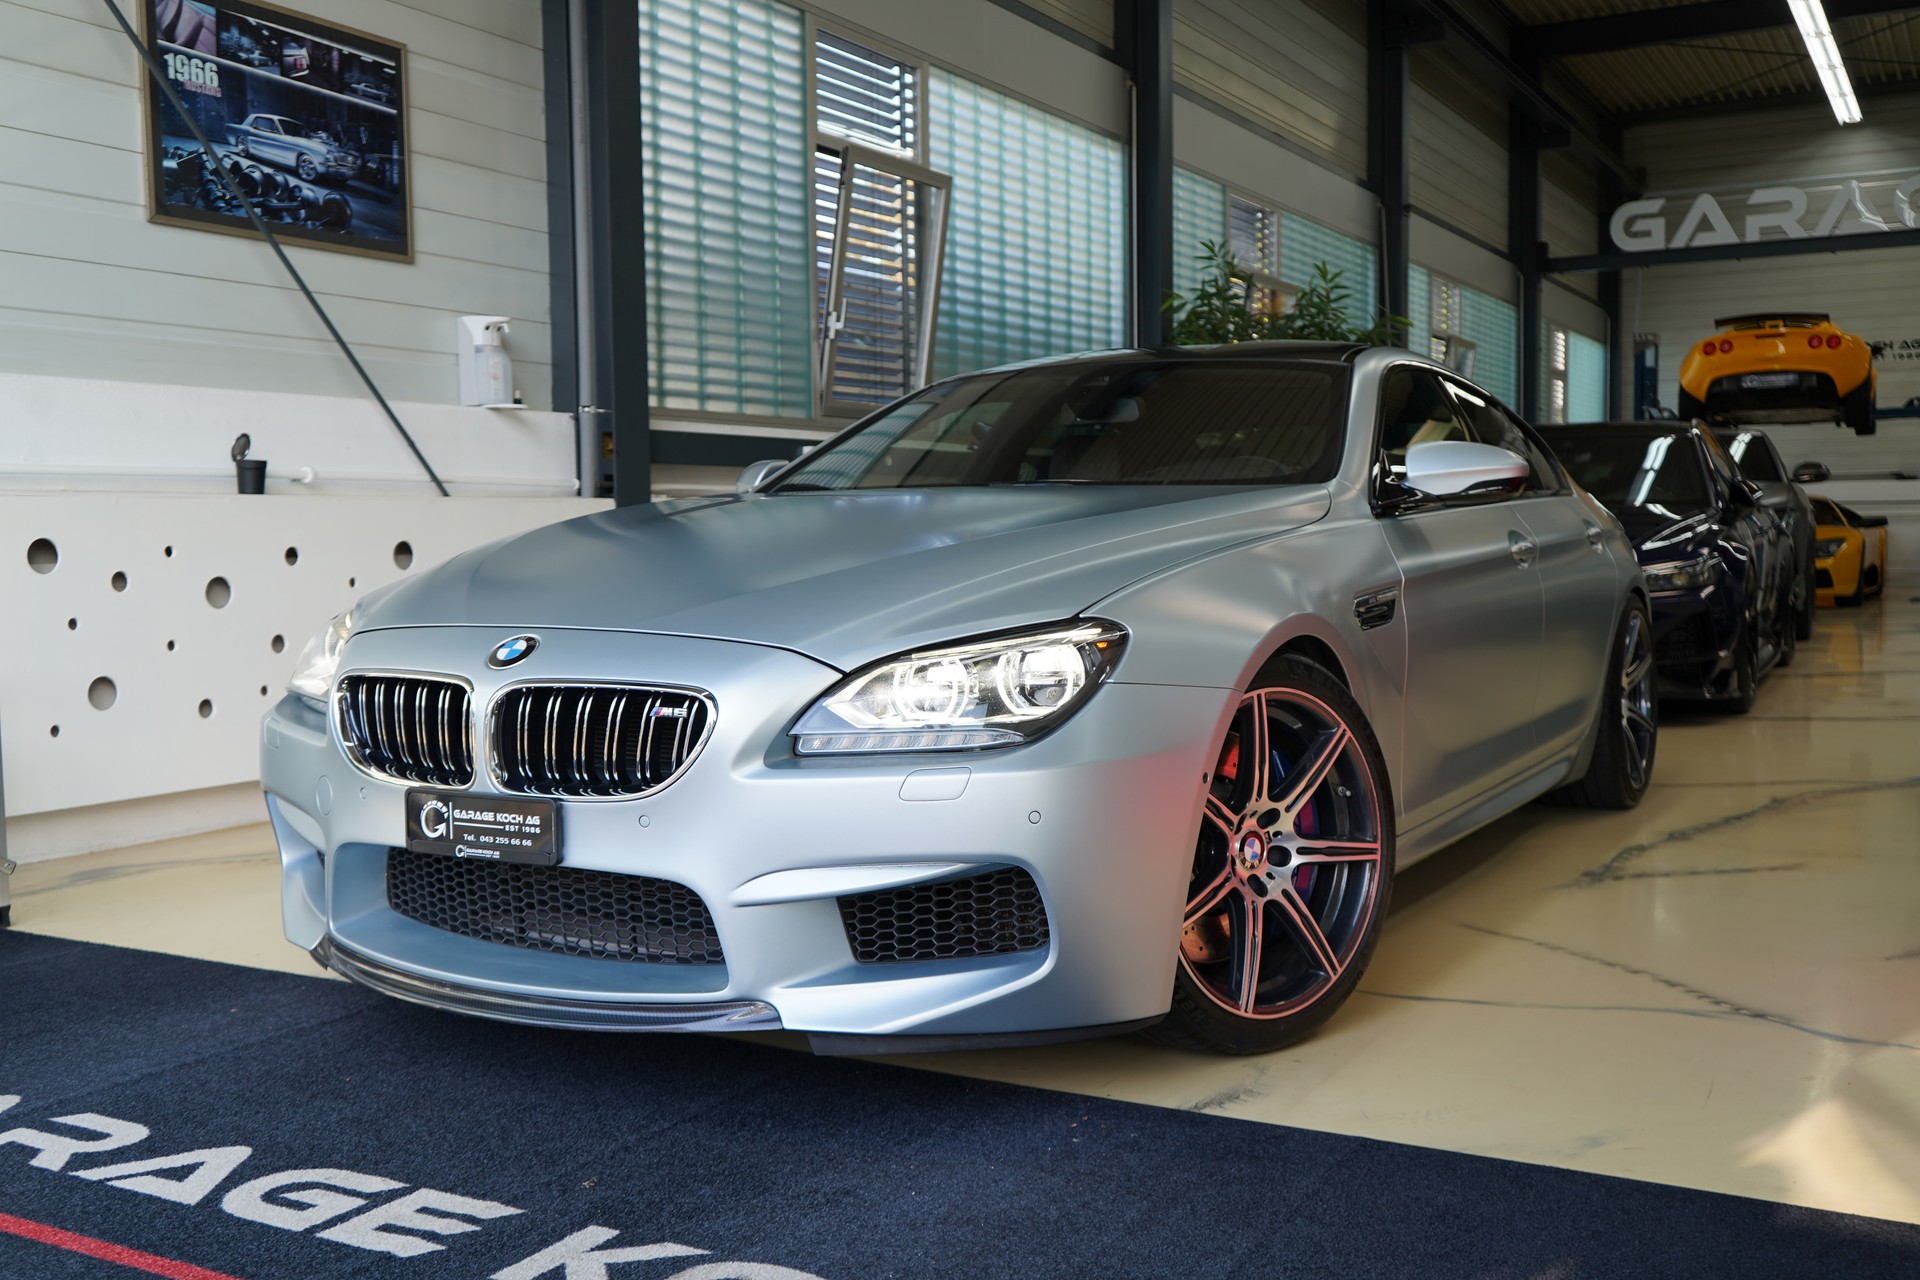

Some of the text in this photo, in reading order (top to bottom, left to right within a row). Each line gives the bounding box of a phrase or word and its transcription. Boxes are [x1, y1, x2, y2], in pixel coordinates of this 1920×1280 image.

[163, 52, 219, 88] 1966
[659, 707, 687, 717] M6
[453, 809, 540, 825] GARAGE KOCH AG
[522, 826, 540, 834] 1986
[480, 835, 493, 843] 043
[0, 1094, 830, 1280] RAGE K
